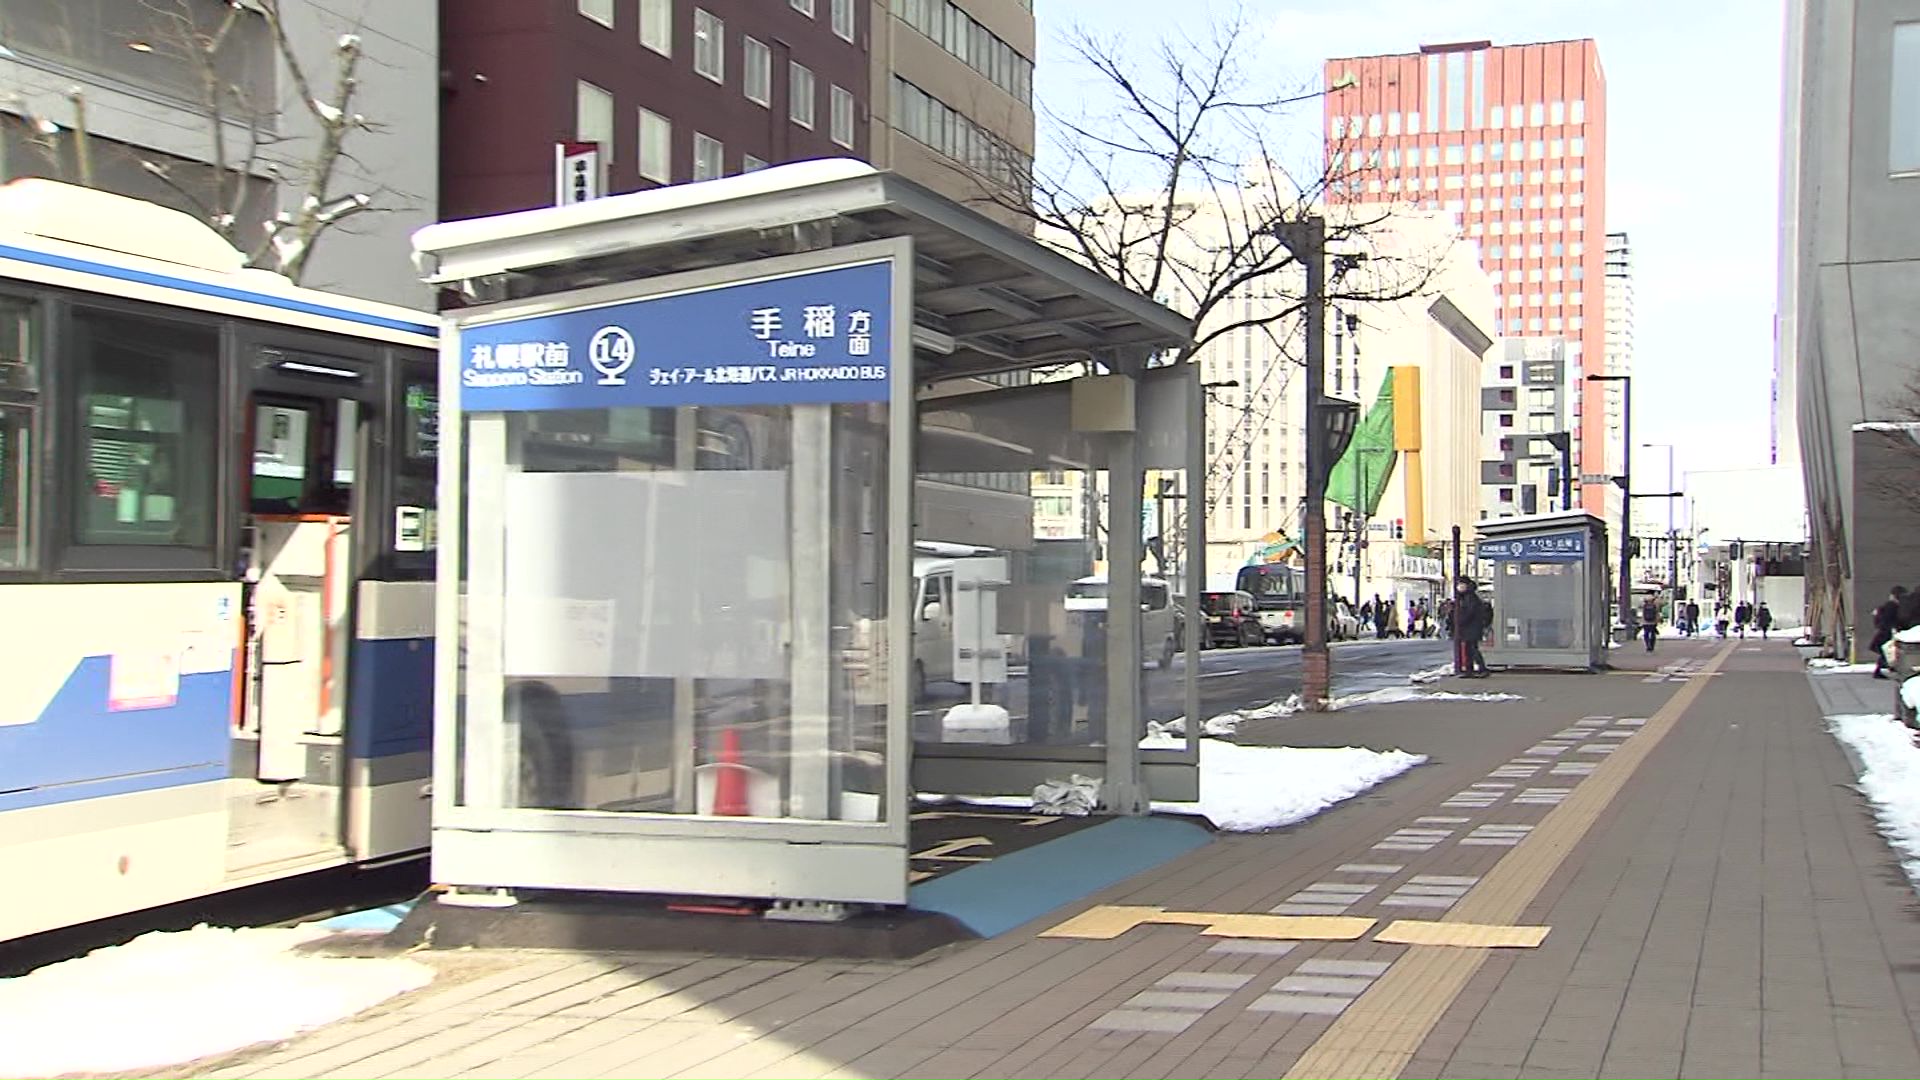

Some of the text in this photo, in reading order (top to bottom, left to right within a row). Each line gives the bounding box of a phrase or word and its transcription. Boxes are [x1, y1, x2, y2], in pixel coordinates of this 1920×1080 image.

[751, 304, 836, 339] 手稲
[848, 310, 872, 356] 方面
[598, 337, 628, 363] 14
[766, 340, 816, 358] Teine
[780, 366, 886, 380] JR HOKKAIDO BUS
